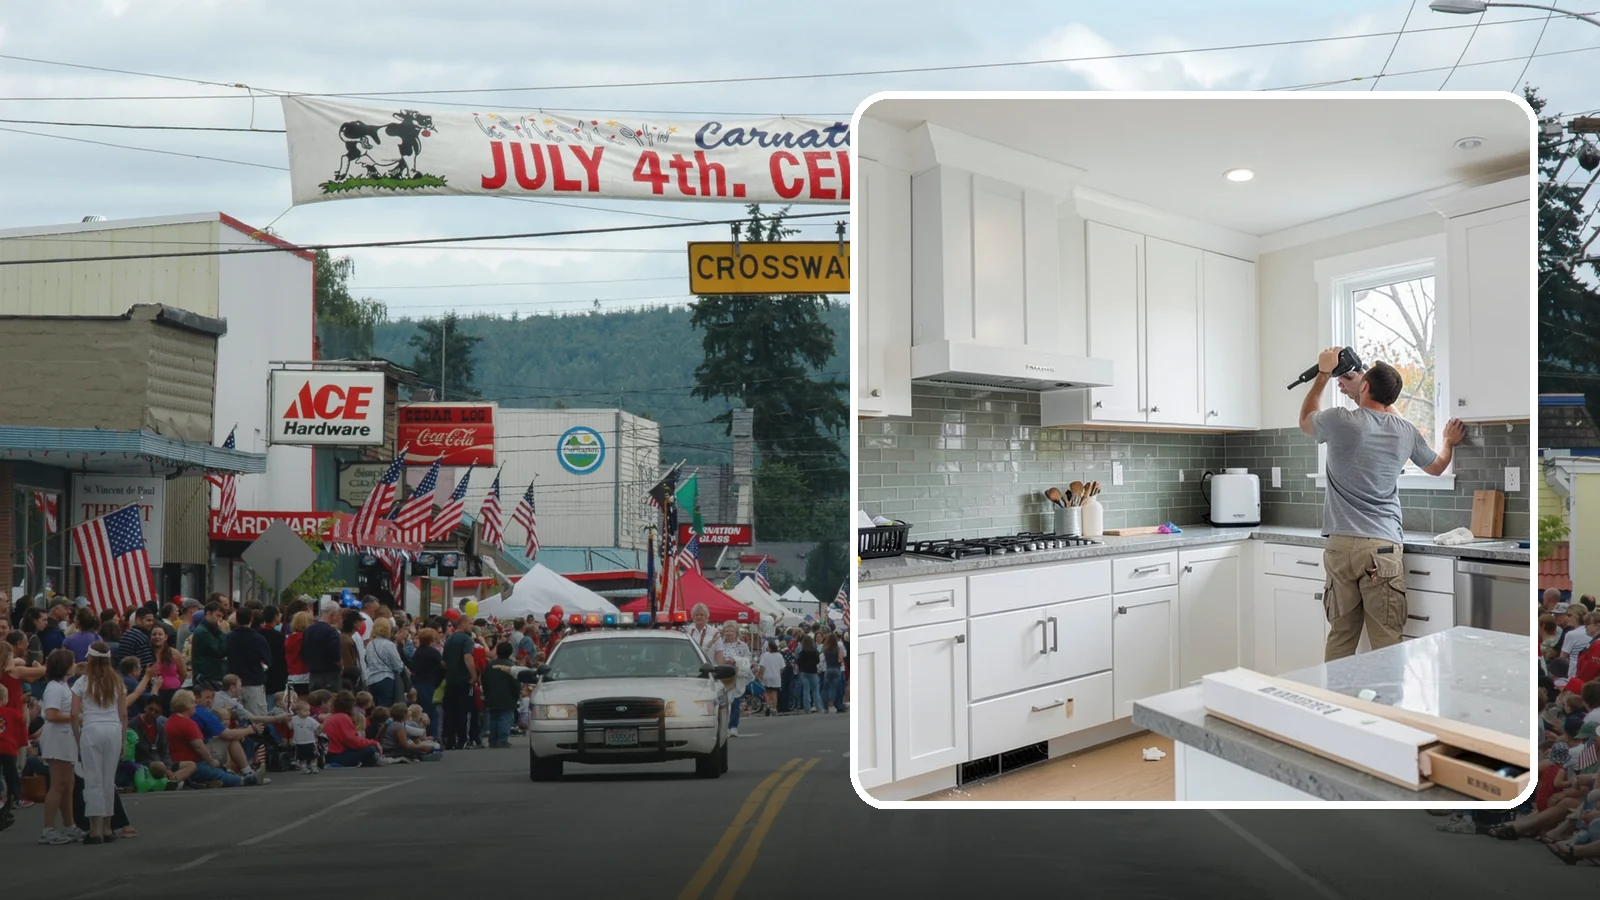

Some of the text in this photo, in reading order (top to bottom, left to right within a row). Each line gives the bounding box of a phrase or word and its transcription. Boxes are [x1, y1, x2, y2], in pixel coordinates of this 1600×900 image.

[481, 141, 605, 193] JULY
[632, 149, 746, 198] 4th.
[697, 254, 850, 280] CROSSWA
[283, 380, 374, 420] ACE
[405, 409, 453, 423] CEDAR
[283, 421, 371, 437] Hardware
[416, 427, 477, 447] Coca-Cola
[353, 466, 384, 479] Simpl
[96, 484, 124, 495] Vincent
[126, 485, 136, 495] de
[137, 486, 156, 496] Paul
[81, 502, 154, 523] THT
[212, 516, 331, 535] HARDARE
[688, 526, 741, 535] CRNATION
[699, 535, 730, 543] GLASS
